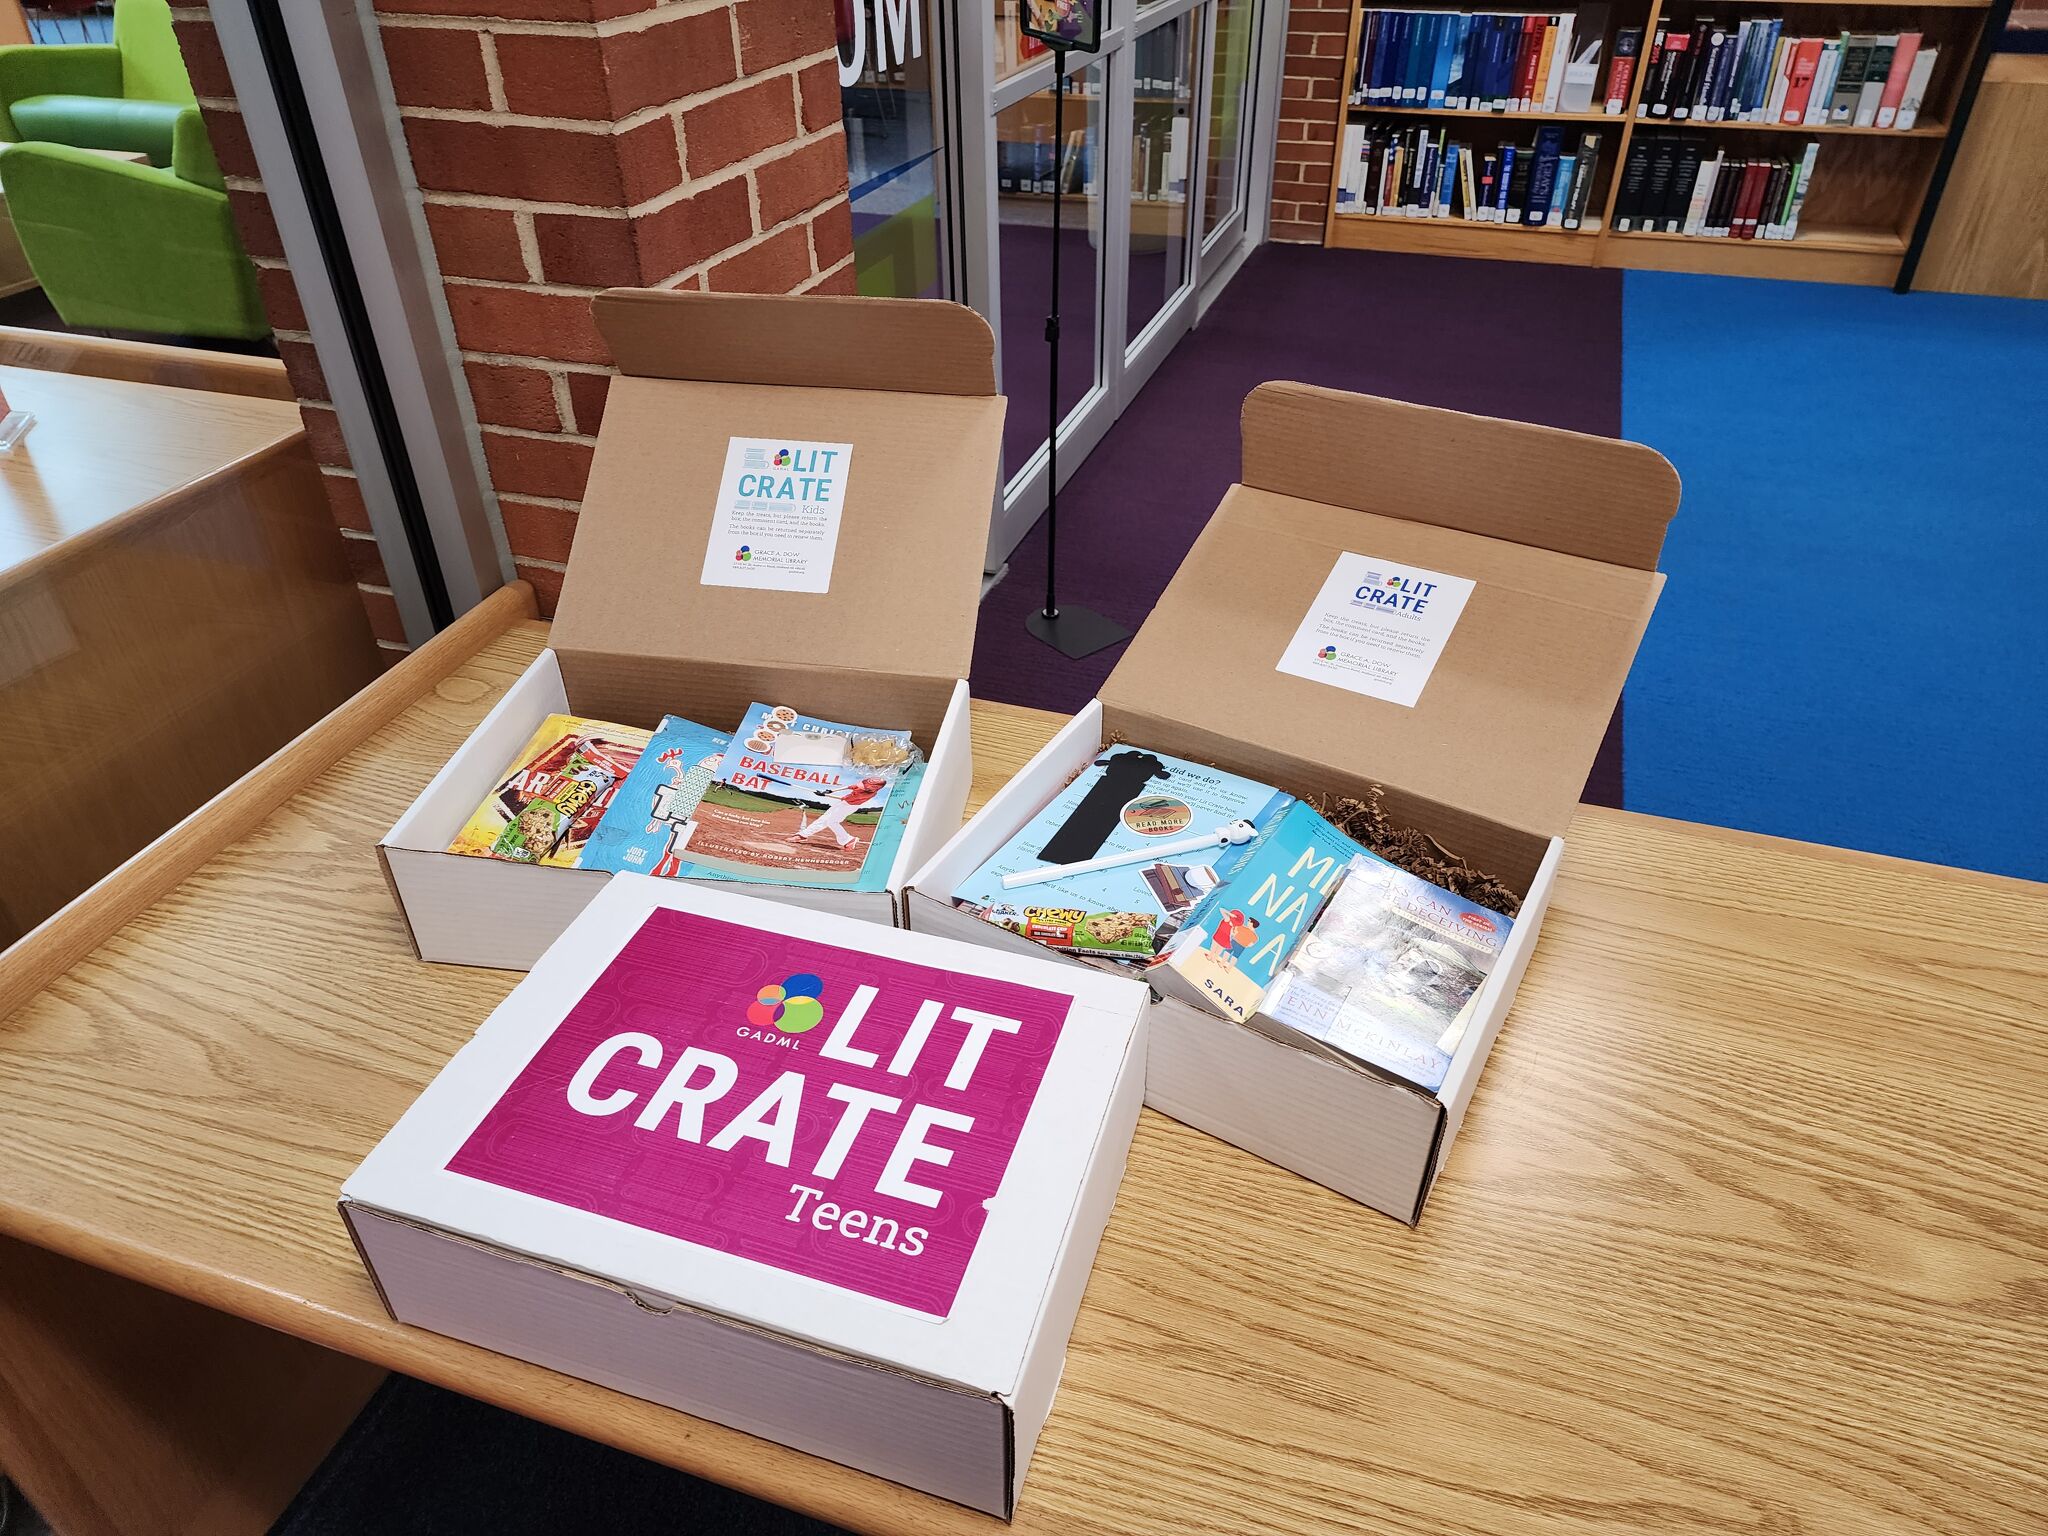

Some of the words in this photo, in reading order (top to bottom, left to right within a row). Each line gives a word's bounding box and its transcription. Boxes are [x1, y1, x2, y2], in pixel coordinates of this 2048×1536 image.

[793, 449, 839, 473] LIT
[738, 474, 833, 502] CRATE
[801, 504, 825, 515] Kids
[1400, 578, 1438, 597] LIT
[1355, 586, 1429, 614] CRATE
[1396, 611, 1422, 622] Adults
[1337, 657, 1371, 669] MEMORIAL
[1372, 665, 1398, 676] LIBRARY
[1340, 651, 1363, 661] GRACE
[1372, 660, 1391, 668] DOW
[739, 755, 843, 786] BASEBALL
[1169, 767, 1186, 775] did
[1187, 772, 1201, 780] we
[1202, 776, 1222, 785] do?
[731, 772, 772, 791] BAT
[1148, 825, 1174, 833] BOOKS
[623, 855, 645, 866] JOHN
[627, 846, 647, 857] JORY
[696, 840, 748, 855] ILLUSTRATED
[794, 857, 850, 865] HENNEBERGER
[1087, 897, 1106, 908] know
[1416, 895, 1453, 916] CAN
[1023, 906, 1087, 923] CHEWY
[1406, 902, 1498, 947] DECEIVING
[1204, 979, 1245, 1017] SARA
[736, 1026, 803, 1052] GADML
[818, 984, 1023, 1092] LIT
[1336, 1019, 1442, 1068] MCKINLAY
[566, 1031, 976, 1209] CRATE
[784, 1183, 929, 1257] Teens
